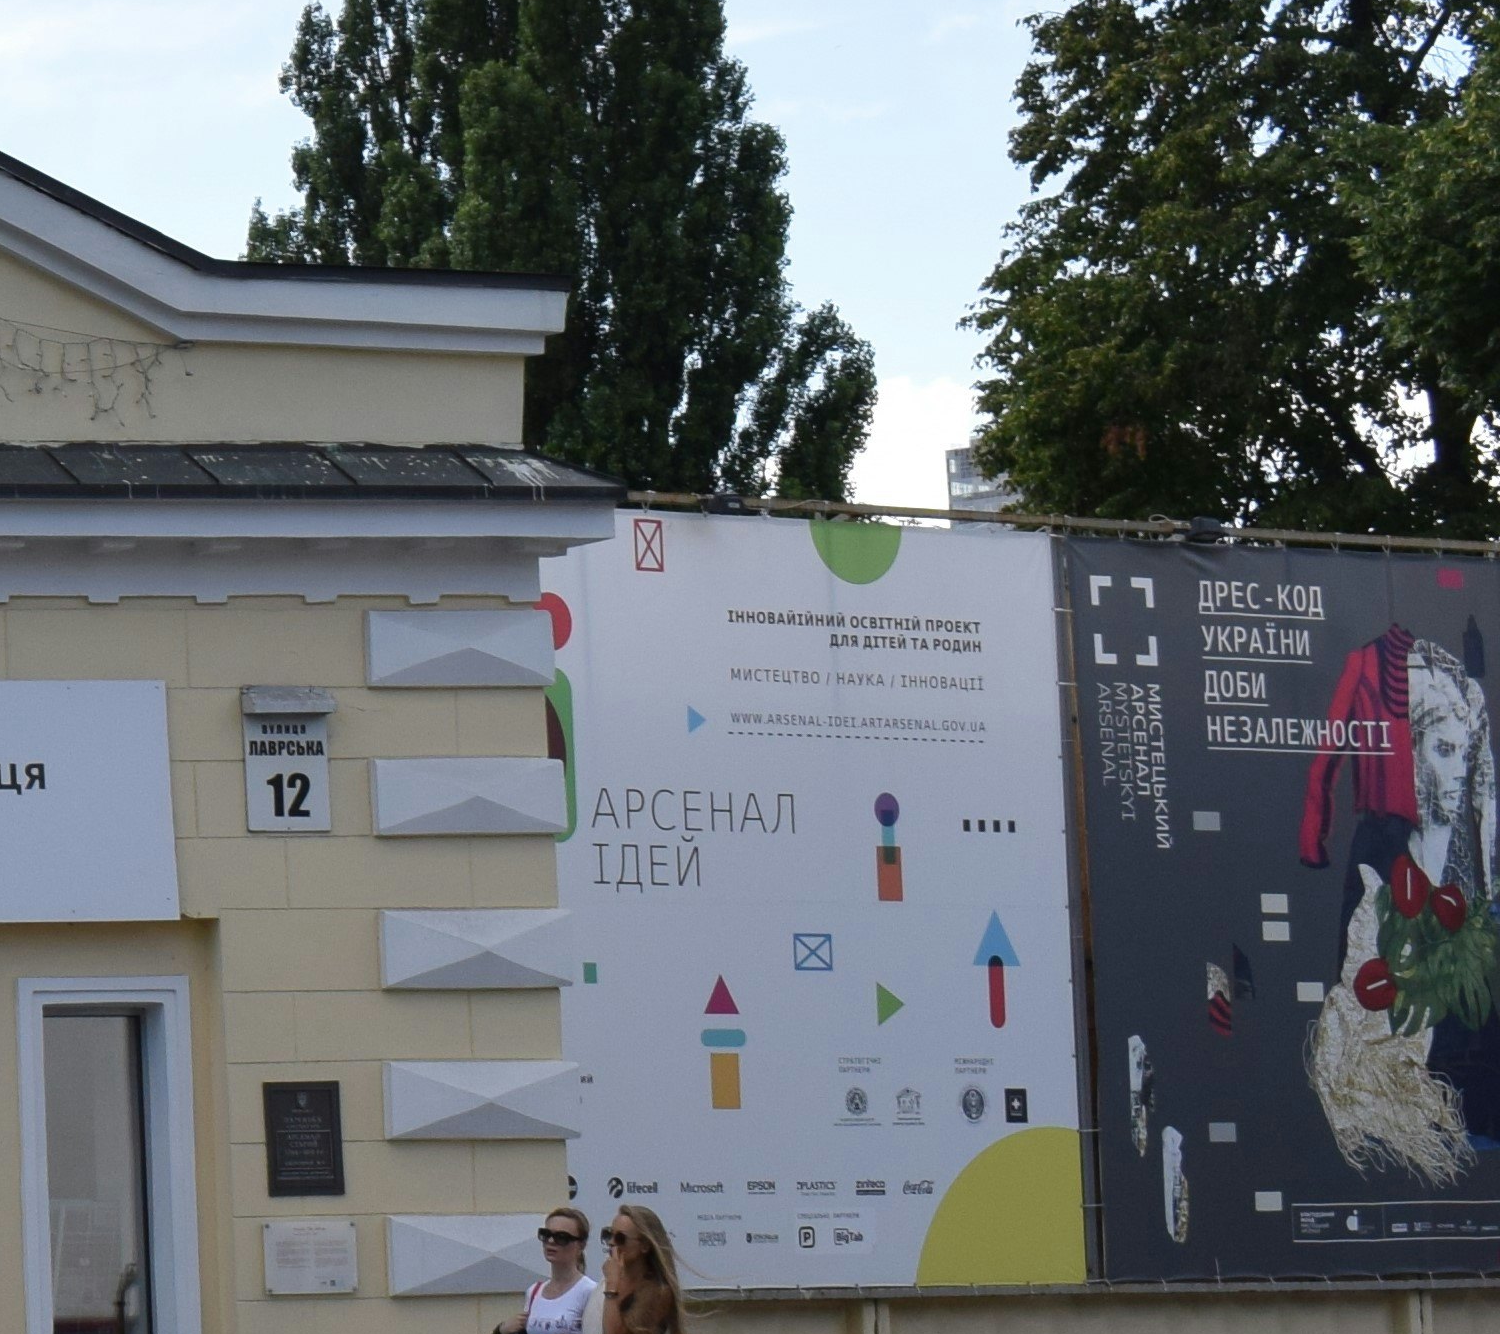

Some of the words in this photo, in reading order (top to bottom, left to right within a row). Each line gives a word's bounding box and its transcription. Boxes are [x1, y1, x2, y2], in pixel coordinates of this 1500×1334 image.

[850, 614, 921, 631] ОСВІТНІЙ
[925, 619, 981, 634] ПРОЕКТ
[1201, 622, 1310, 656] УКРАЇНИ
[829, 633, 859, 649] ДЛЯ
[863, 633, 906, 651] ДІТЕЙ
[910, 637, 929, 650] ТА
[933, 638, 982, 654] РОДИН
[730, 667, 820, 685] МИСТЕЦТВО
[836, 673, 886, 687] НАУКА
[900, 674, 985, 692] ІННОВАЦІЇ
[1204, 669, 1266, 702] ДОБИ
[730, 711, 986, 733] WWW.ARSENAL-IDEI.ARTARSENAL.GOV.UA
[1096, 682, 1117, 787] ARSENAL
[1206, 714, 1391, 748] НЕЗАЛЕЖНОСТІ
[249, 740, 324, 756] ЛАВРСЬКА
[1112, 682, 1136, 821] MYSTETSKYI
[1129, 683, 1151, 796] АРСЕНАЛ
[1146, 683, 1173, 849] МИСТЕЦЬКИЙ
[266, 772, 311, 817] 12
[591, 787, 797, 835] АРСЕНАЛ
[592, 836, 702, 893] ІДЕЙ
[626, 1181, 658, 1194] lifecell
[680, 1181, 724, 1193] Microsoft
[747, 1180, 776, 1191] EPSON
[836, 1231, 864, 1244] BigTab
